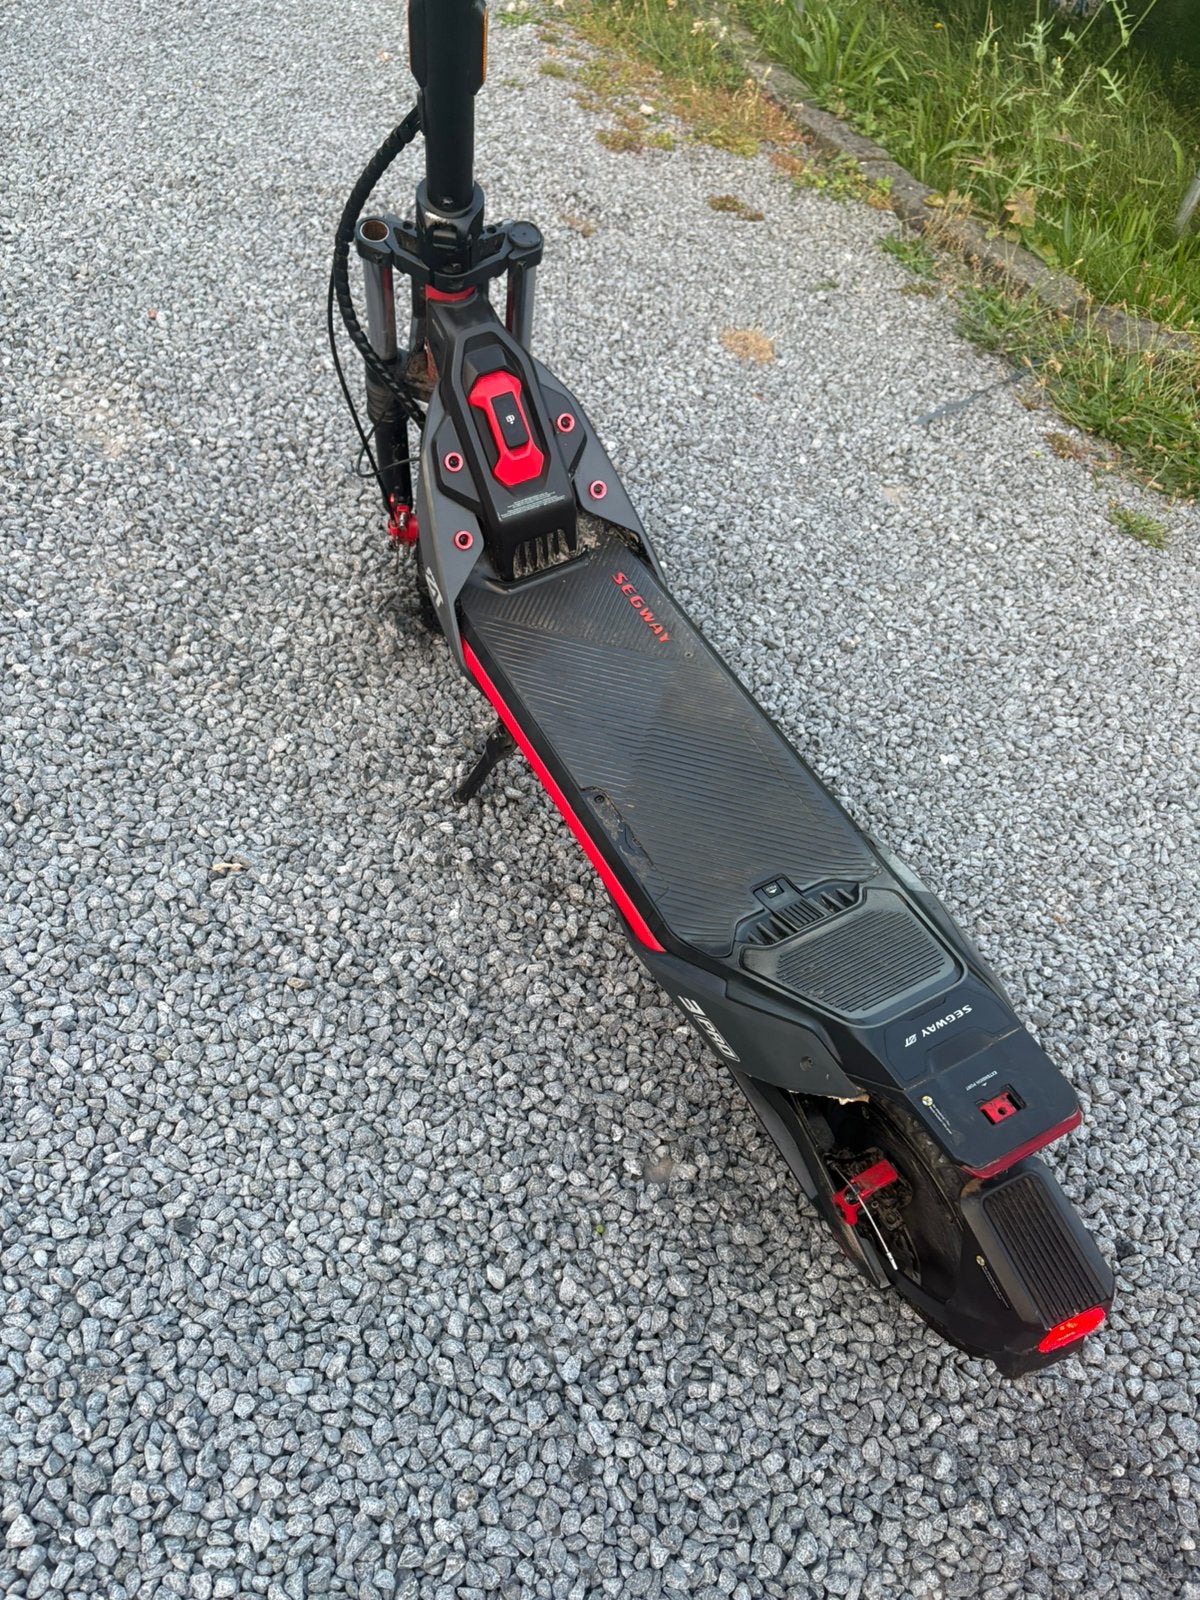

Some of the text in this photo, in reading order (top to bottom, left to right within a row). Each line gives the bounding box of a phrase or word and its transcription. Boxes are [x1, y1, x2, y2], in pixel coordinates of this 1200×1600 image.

[611, 572, 670, 642] SEGWAY
[696, 1017, 737, 1059] PRO
[921, 1004, 973, 1038] SEGWAY
